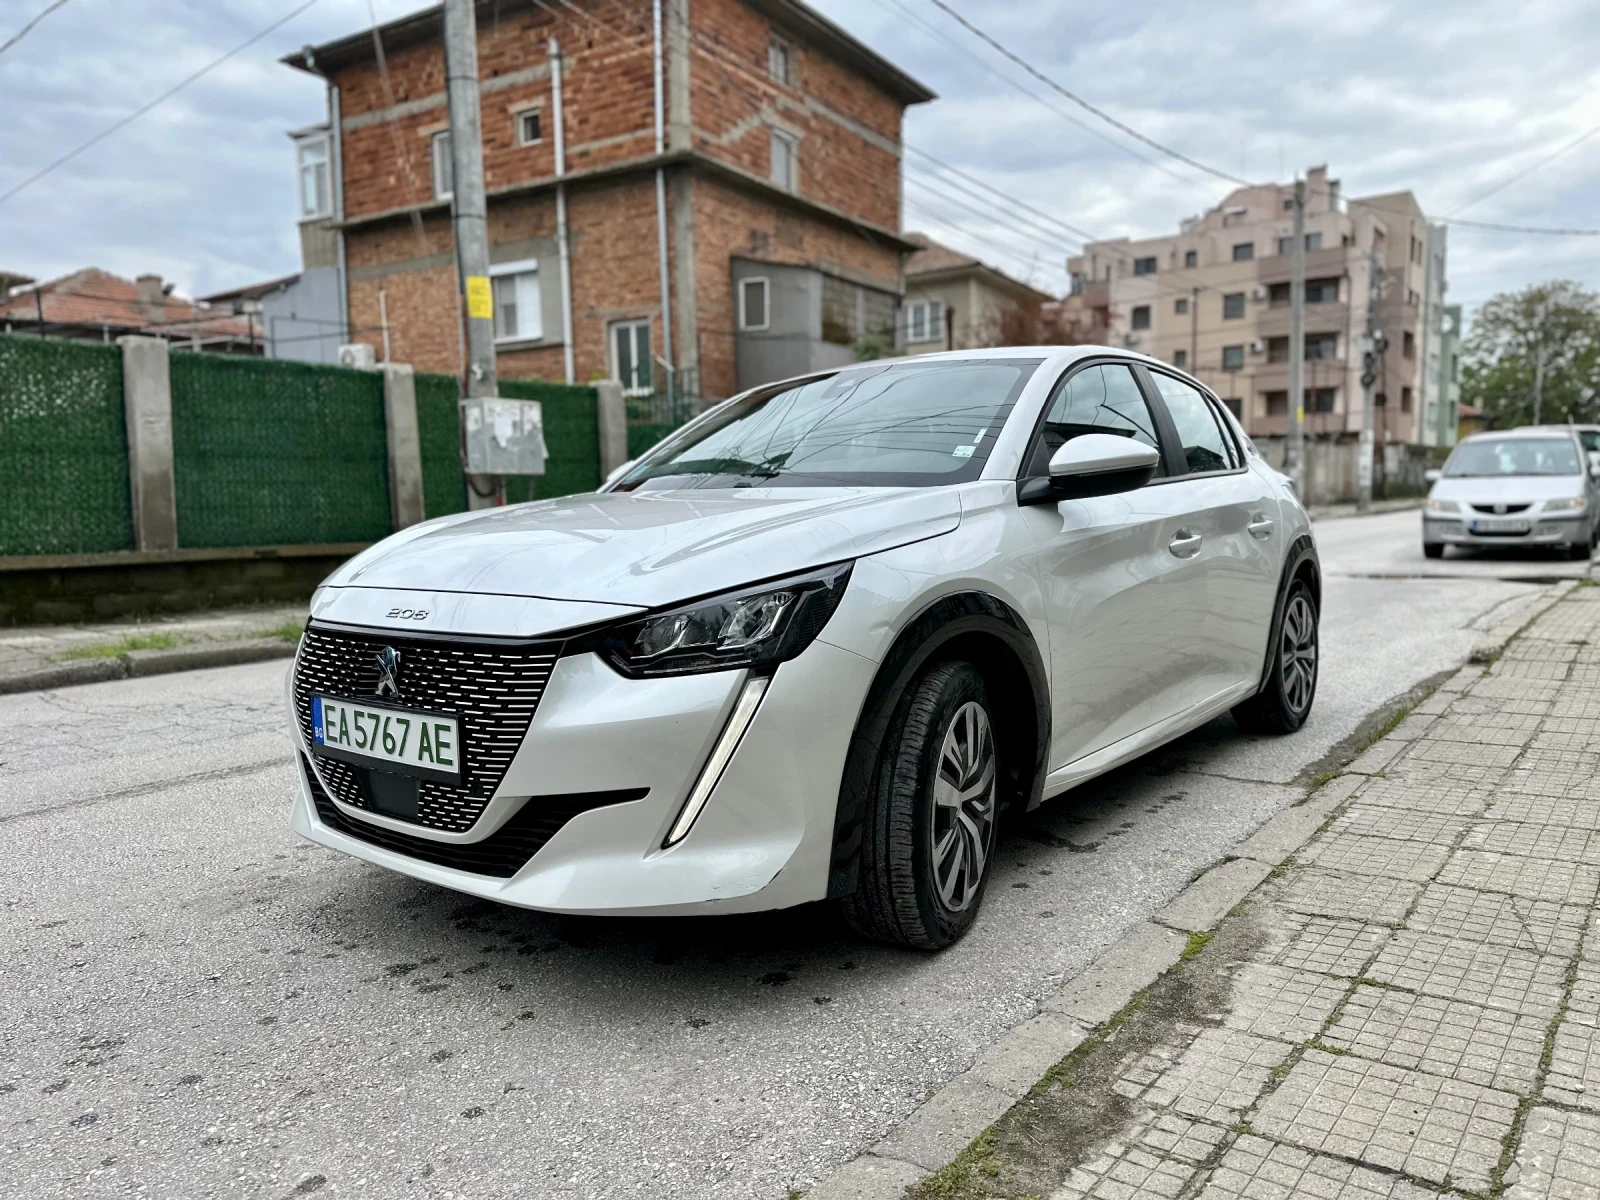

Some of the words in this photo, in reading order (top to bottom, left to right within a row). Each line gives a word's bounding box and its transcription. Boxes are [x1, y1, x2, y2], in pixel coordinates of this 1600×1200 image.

[385, 607, 429, 620] 208
[314, 726, 323, 738] BG
[418, 722, 453, 766] AE
